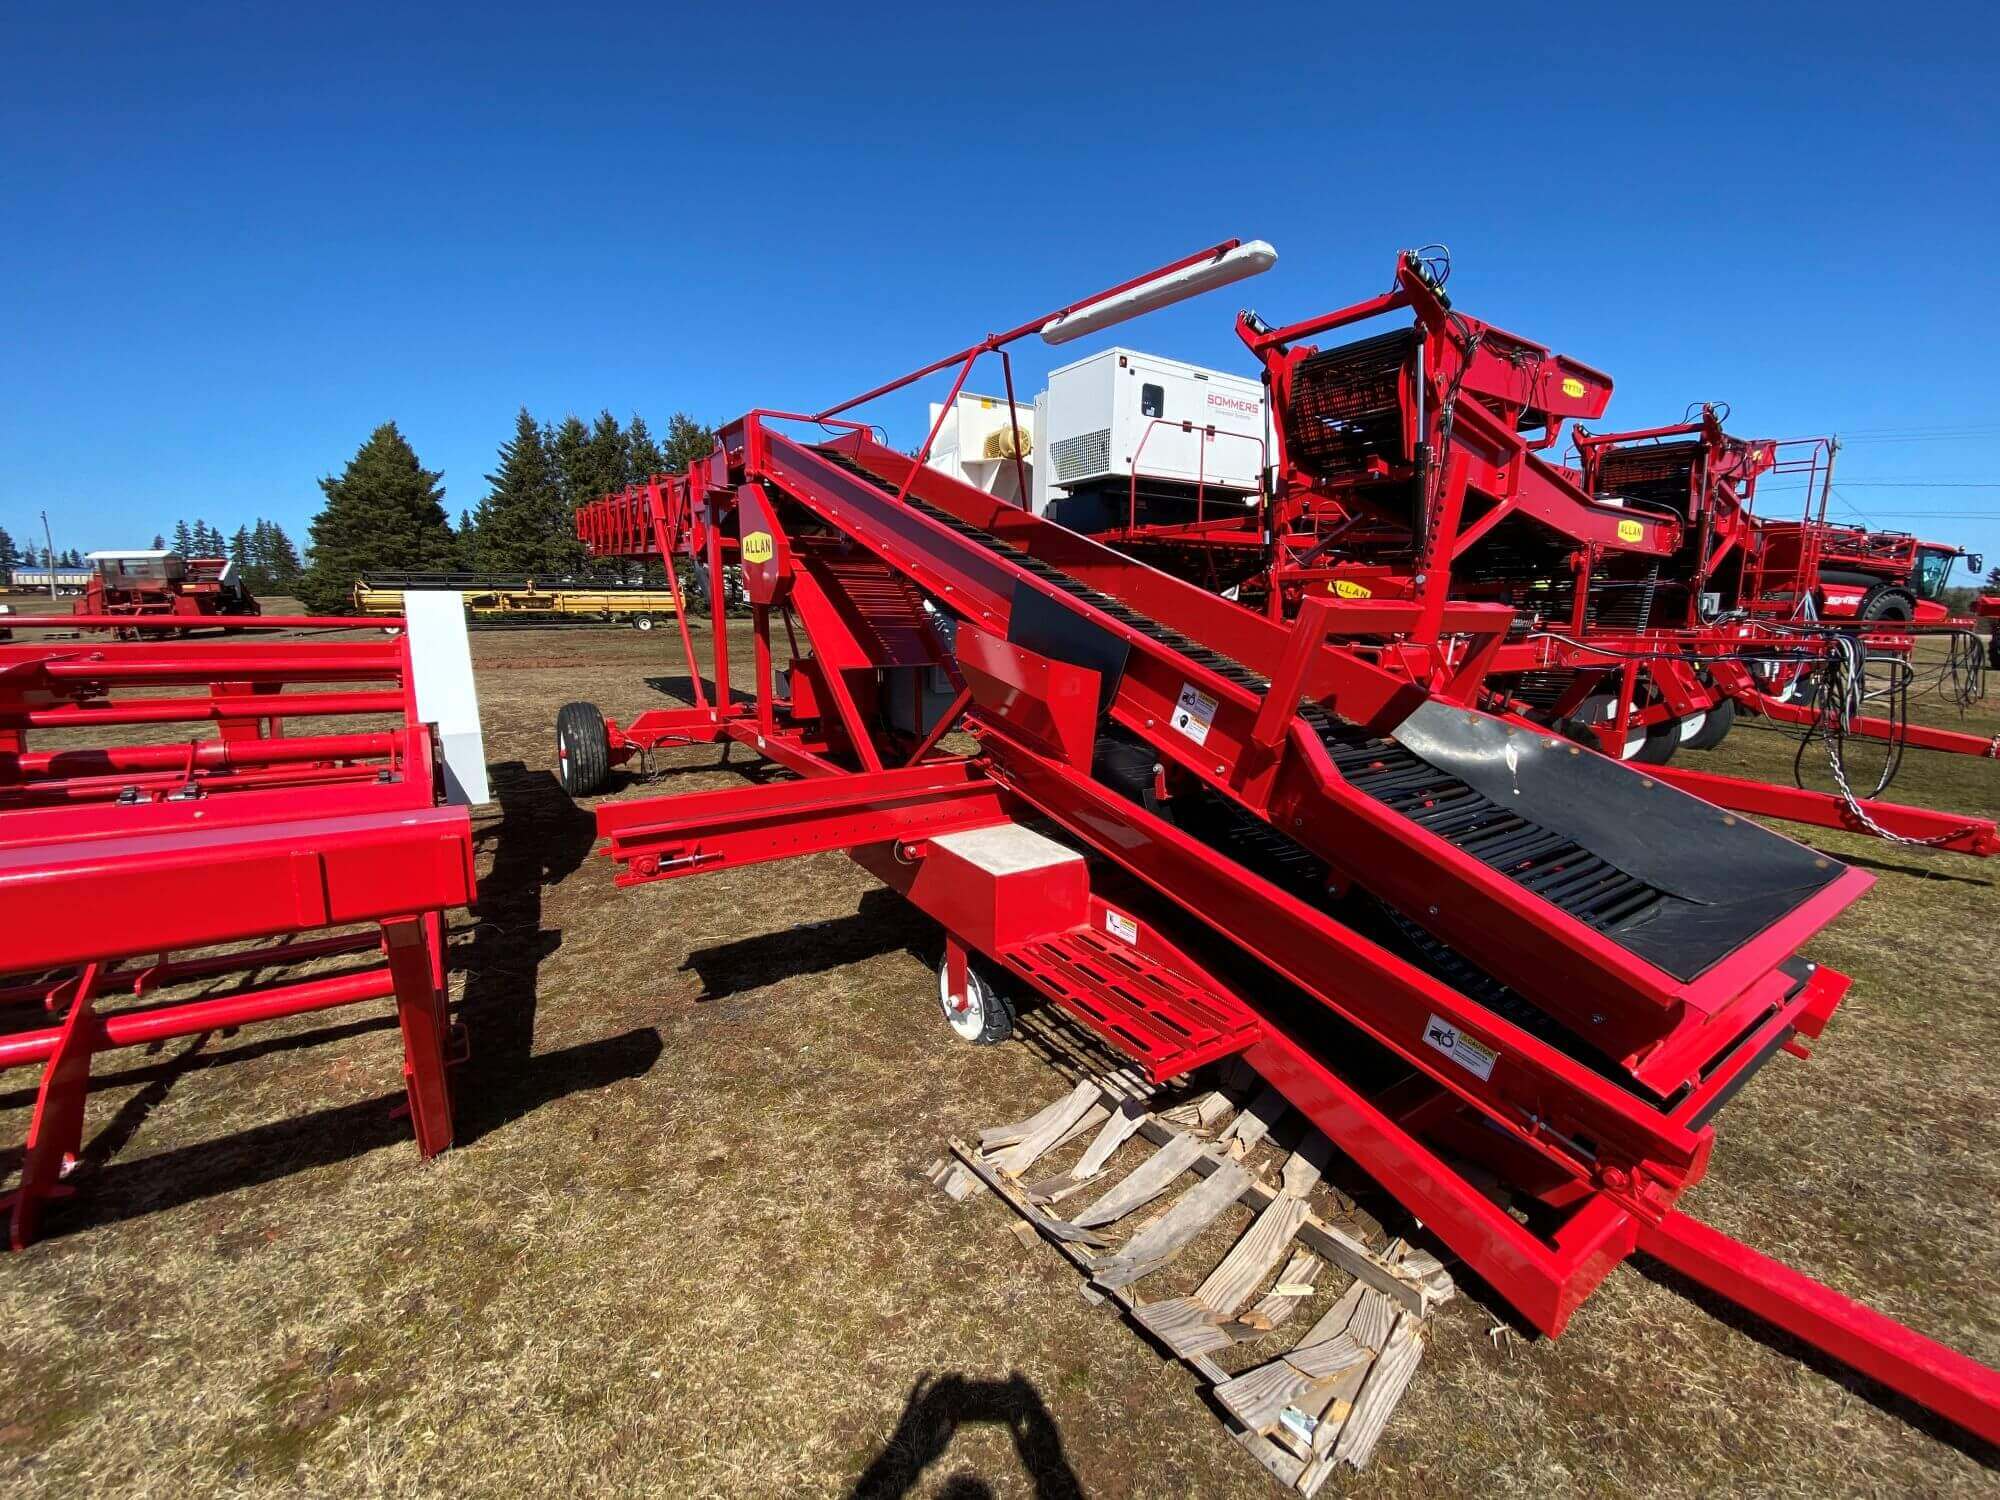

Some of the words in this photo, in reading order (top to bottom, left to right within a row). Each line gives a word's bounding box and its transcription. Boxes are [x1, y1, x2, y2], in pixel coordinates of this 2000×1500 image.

[1208, 394, 1259, 414] SOMMERS
[745, 538, 771, 554] ALLAN
[1337, 583, 1368, 598] LLAN
